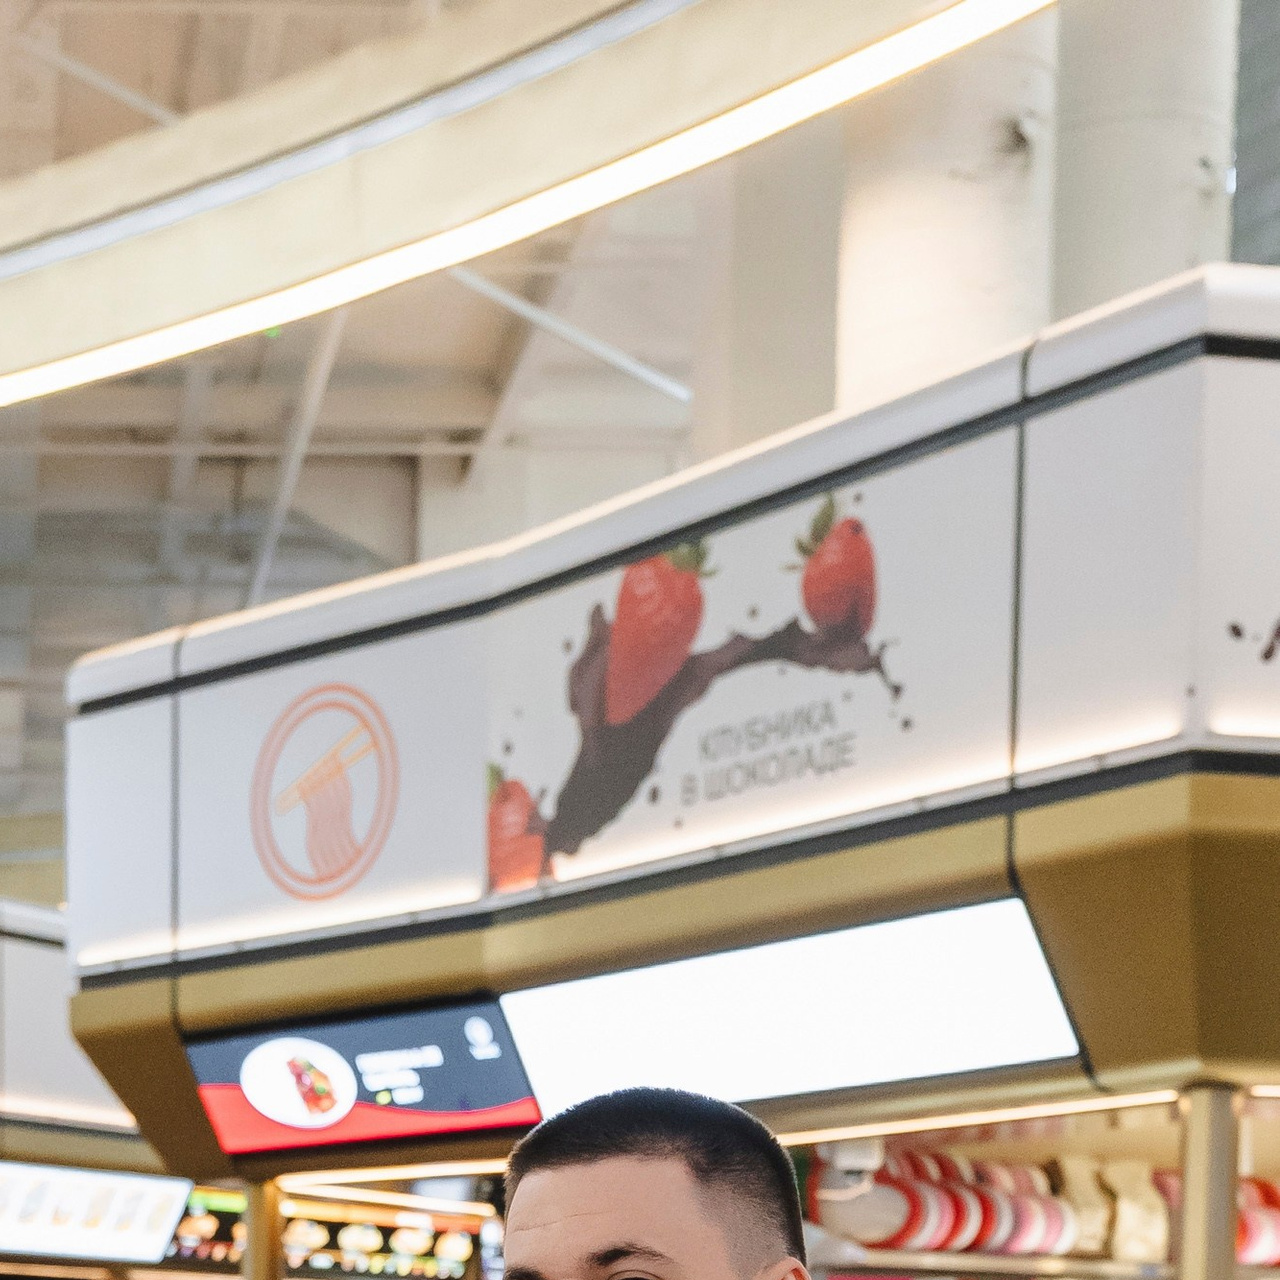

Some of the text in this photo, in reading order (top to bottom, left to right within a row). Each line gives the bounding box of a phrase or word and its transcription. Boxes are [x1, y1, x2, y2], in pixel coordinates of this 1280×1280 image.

[698, 700, 837, 764] КЛУБНИКА
[681, 730, 857, 808] В ШОКОЛАДЕ
